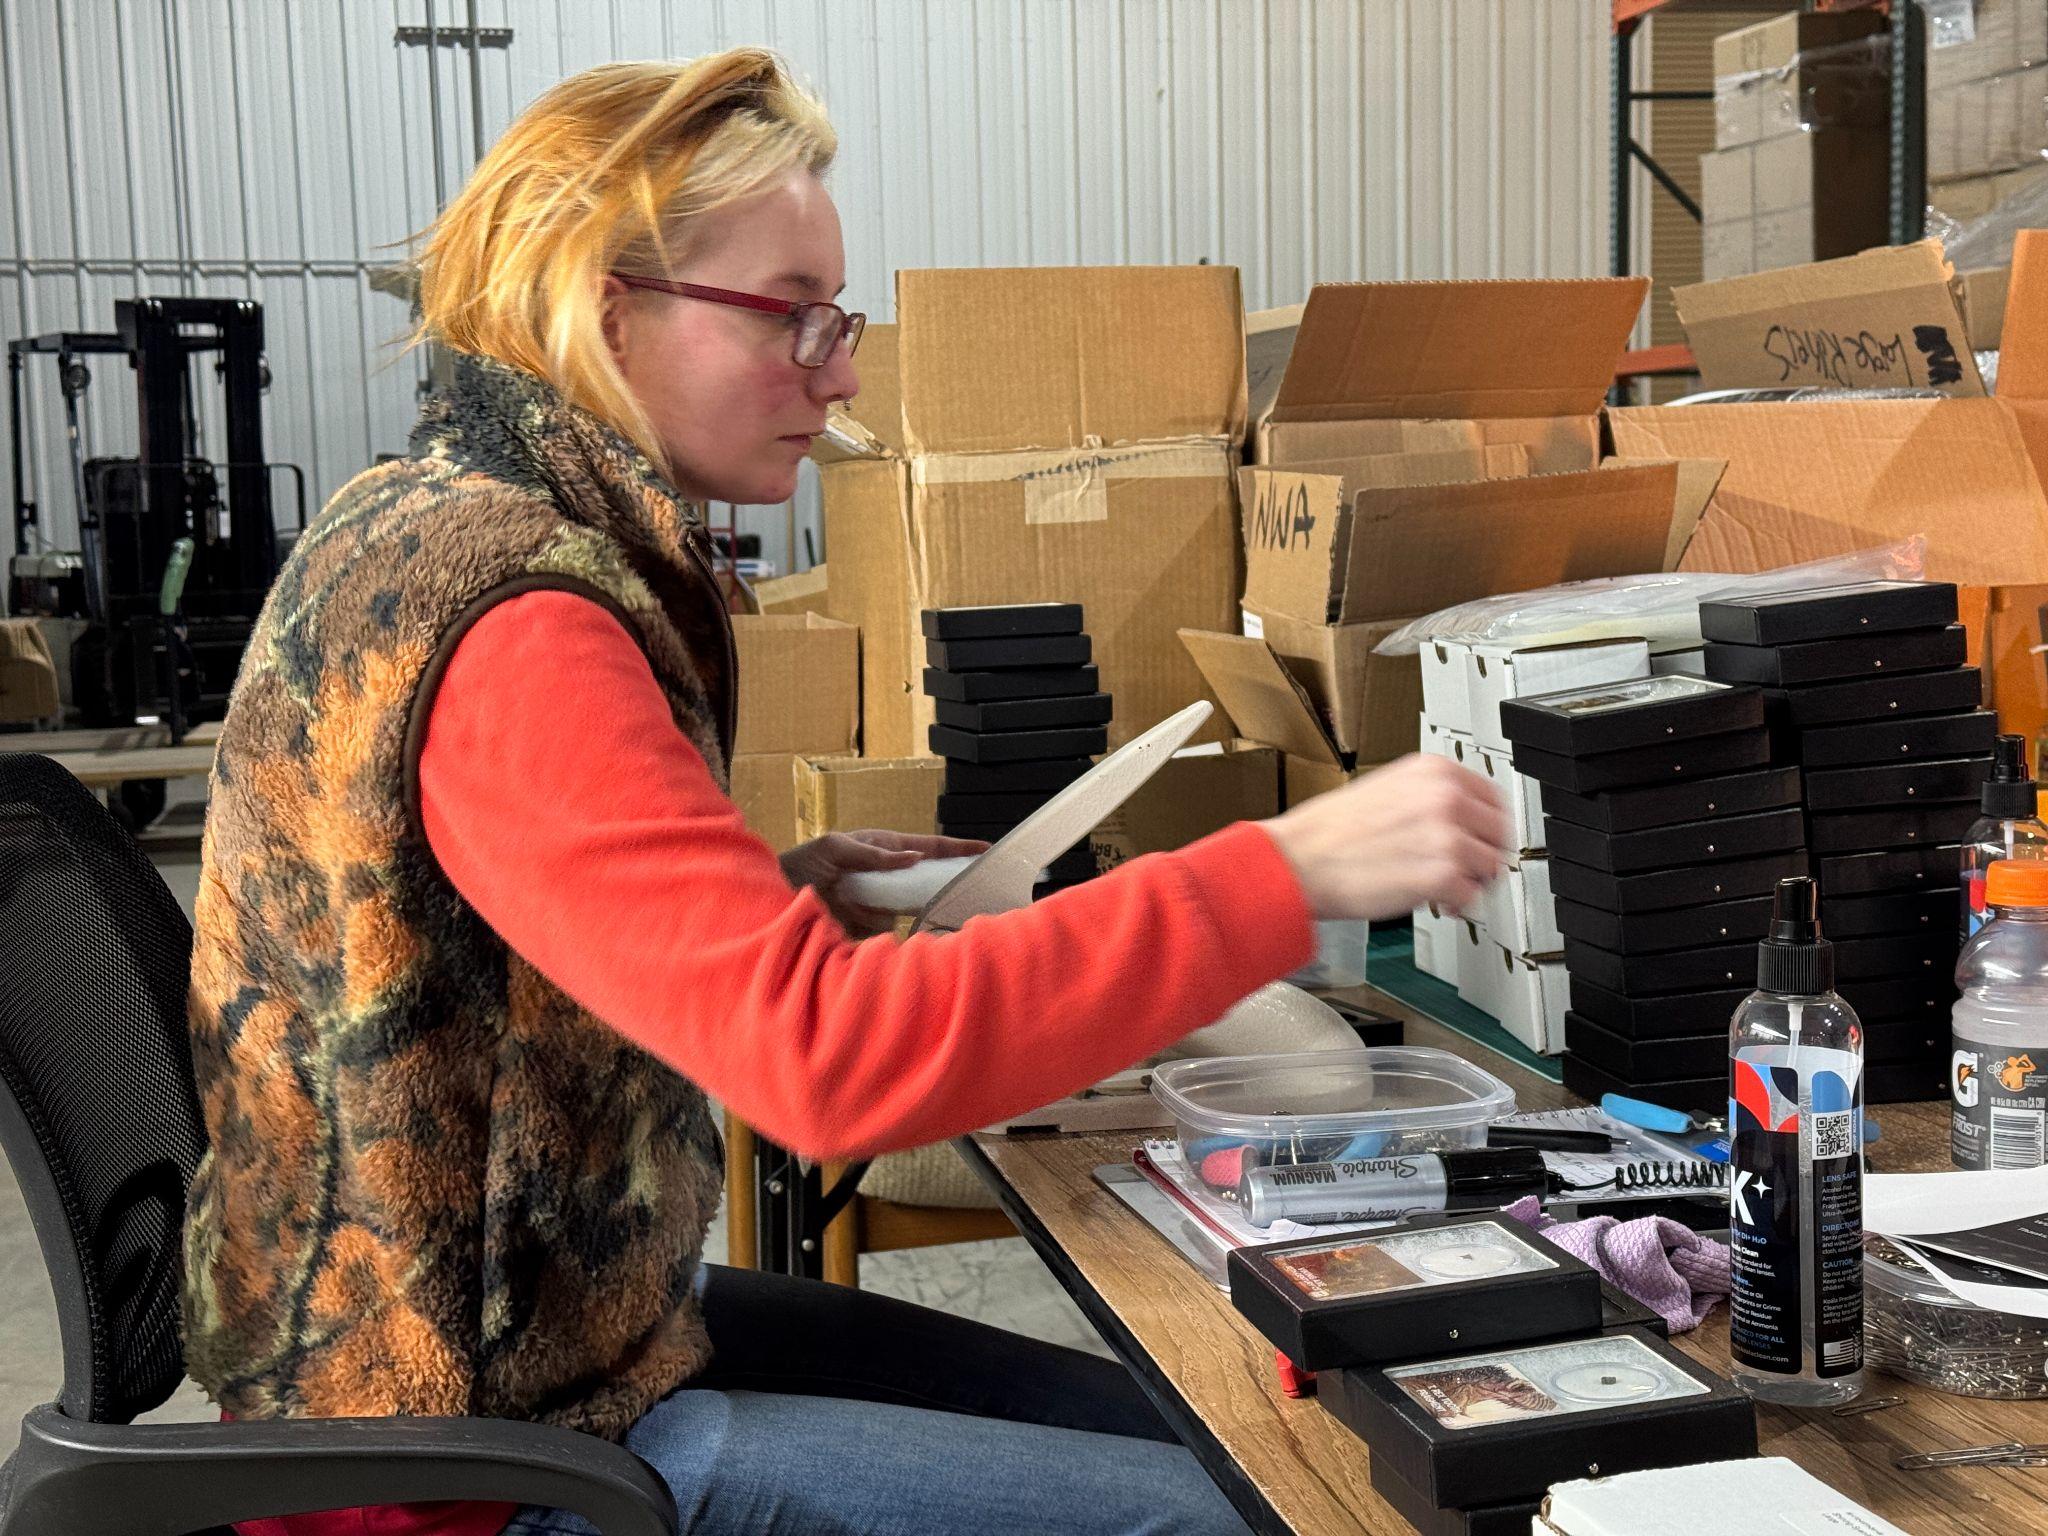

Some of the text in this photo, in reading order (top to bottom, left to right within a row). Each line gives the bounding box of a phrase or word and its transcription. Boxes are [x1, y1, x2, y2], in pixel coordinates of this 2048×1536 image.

[1254, 471, 1316, 552] NWA
[1952, 1050, 1979, 1108] G
[1952, 1119, 1980, 1138] FROST
[1341, 1156, 1420, 1178] Sharpie
[1822, 1175, 1841, 1183] LENS
[1731, 1164, 1755, 1226] K
[1822, 1258, 1854, 1269] CAUTION
[1750, 1310, 1773, 1321] Residue
[1750, 1320, 1779, 1331] Ammonia
[1770, 1336, 1786, 1344] ALL
